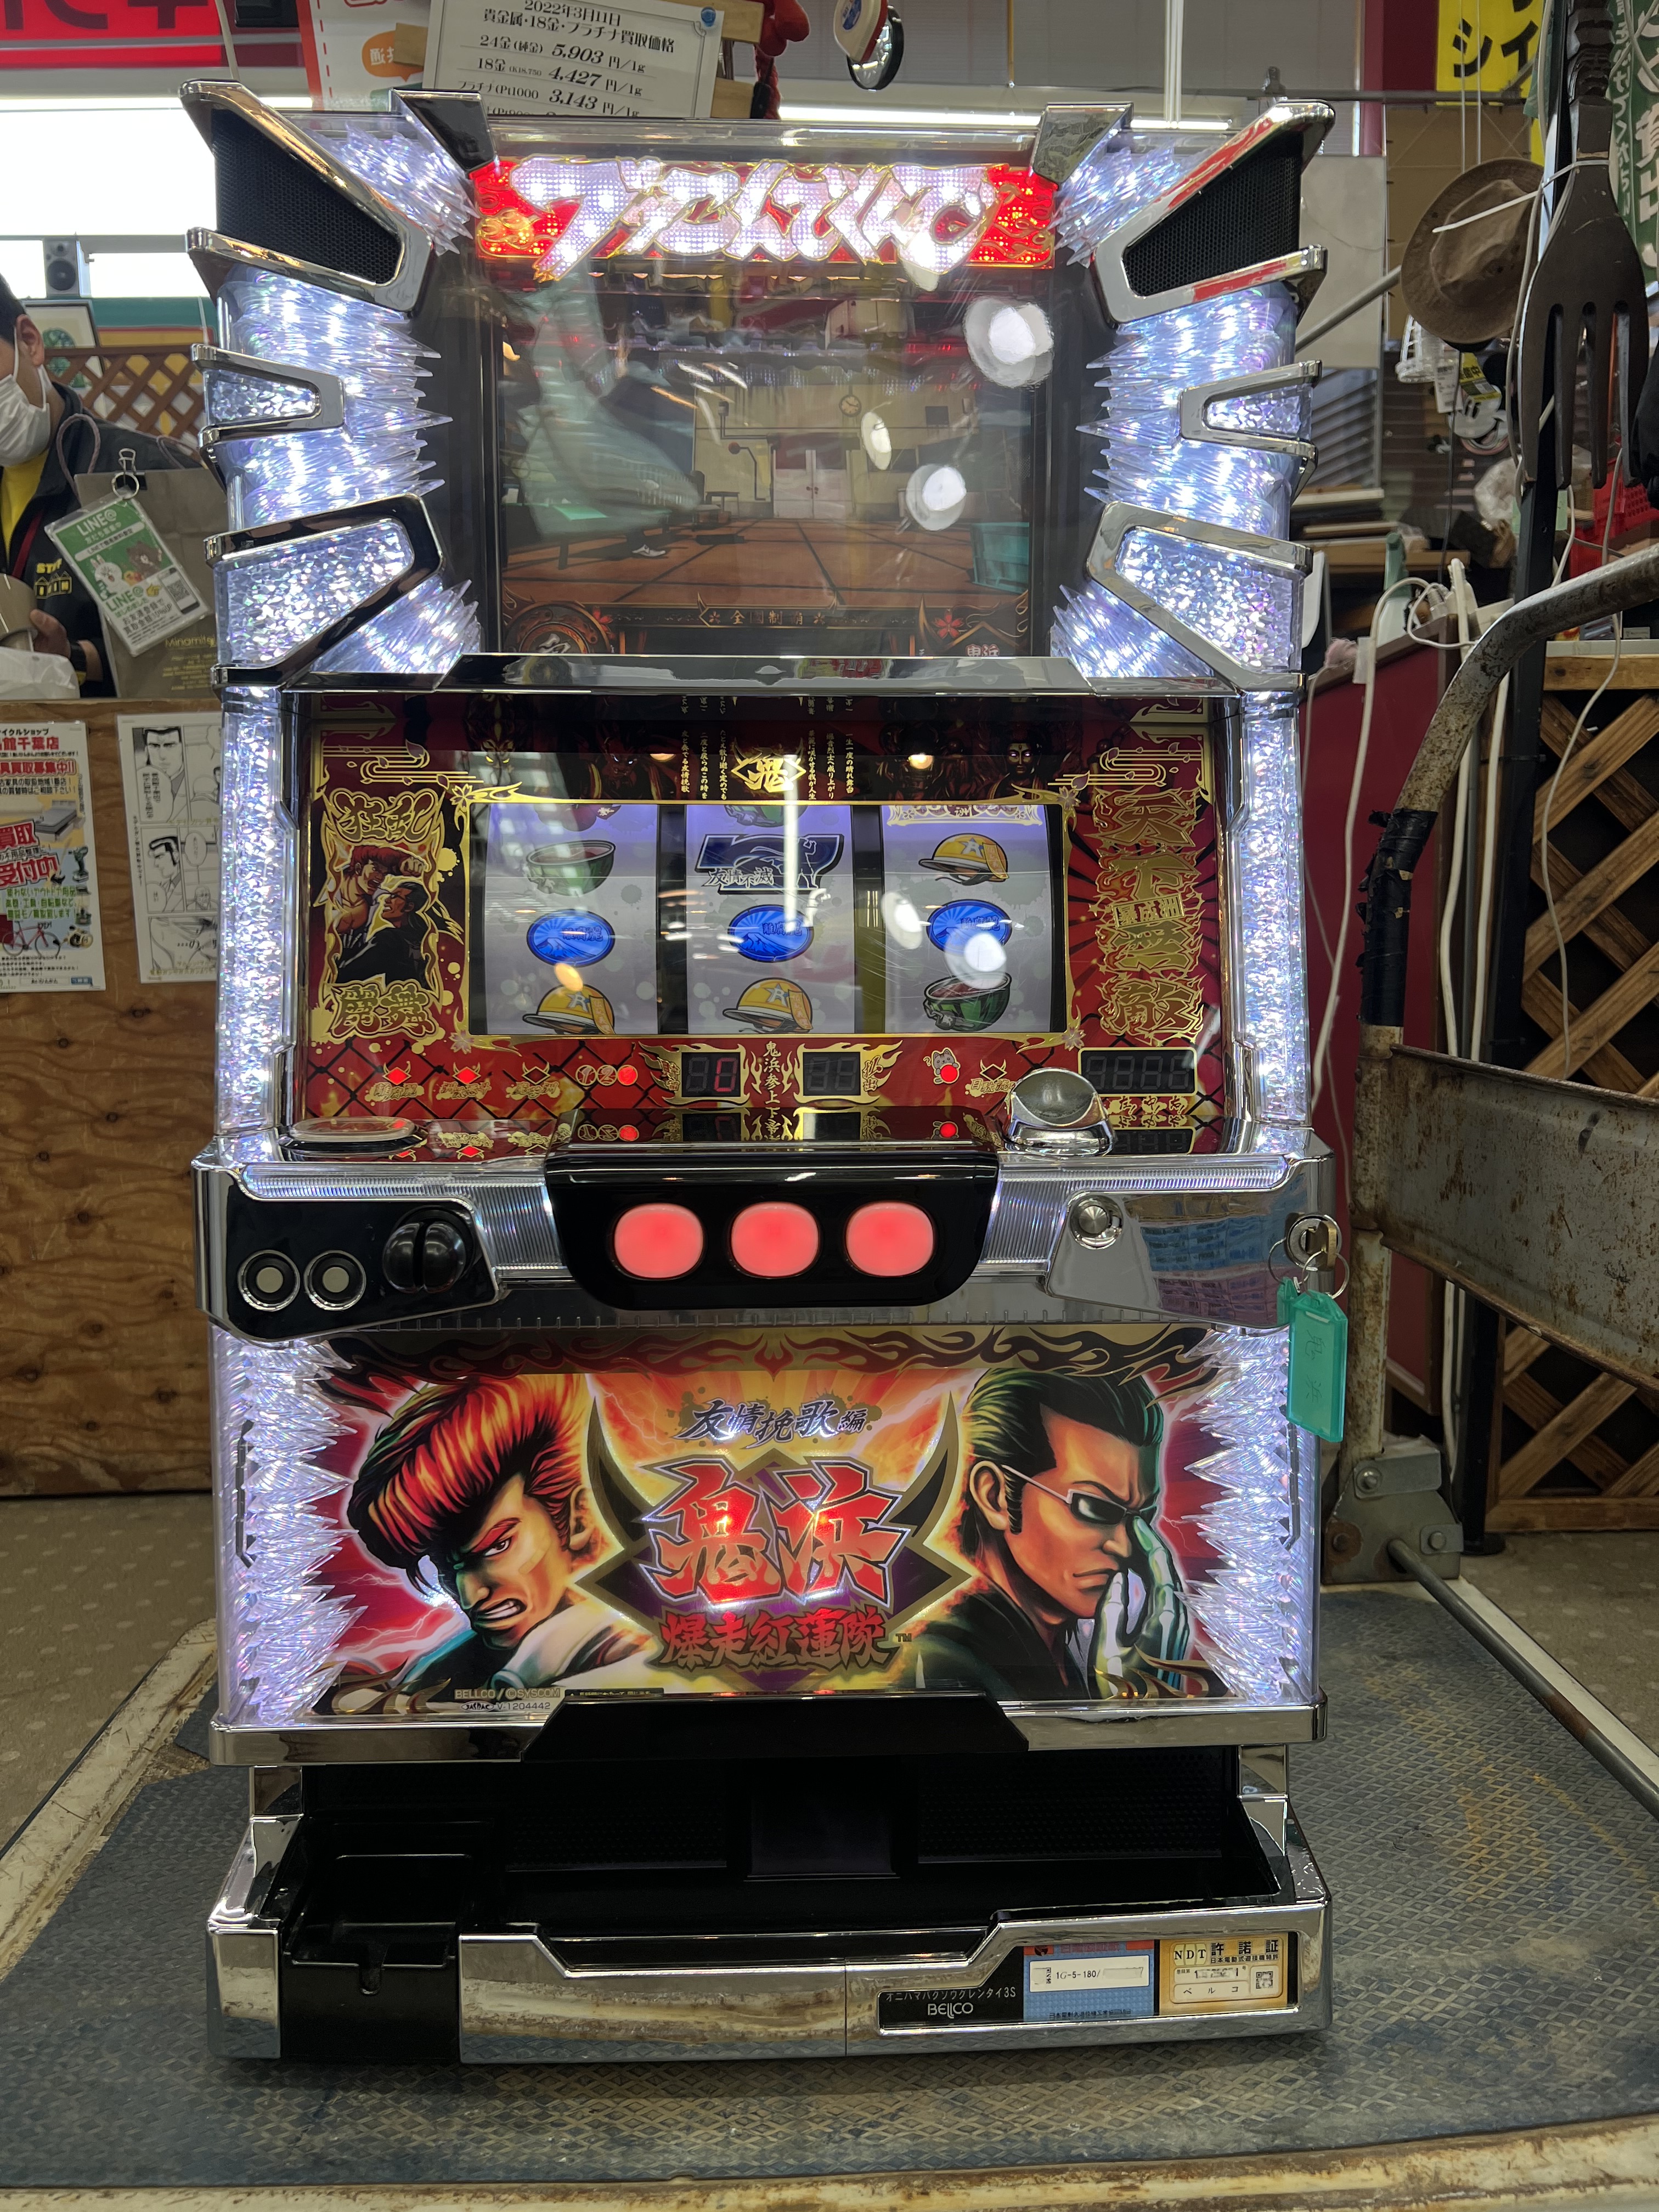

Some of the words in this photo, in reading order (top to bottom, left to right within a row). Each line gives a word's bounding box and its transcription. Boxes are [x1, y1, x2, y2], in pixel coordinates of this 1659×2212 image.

[552, 43, 605, 65] 5,903
[549, 66, 602, 87] 4,427
[549, 89, 599, 110] 3,143
[77, 509, 117, 536] LINE@
[108, 586, 144, 612] LINE@
[0, 737, 59, 751] 館千葉店
[763, 1041, 782, 1104] 鬼浜参上
[673, 1398, 868, 1450] 友情挽歌編
[639, 1457, 912, 1607] 鬼浜
[657, 1606, 894, 1669] 爆走紅蓮隊
[454, 1689, 495, 1700] BELLCO
[496, 1702, 550, 1711] V-1204442
[1174, 1949, 1206, 1960] NDT
[1183, 1986, 1239, 1995] ベルコ
[928, 2002, 974, 2019] BELLCO
